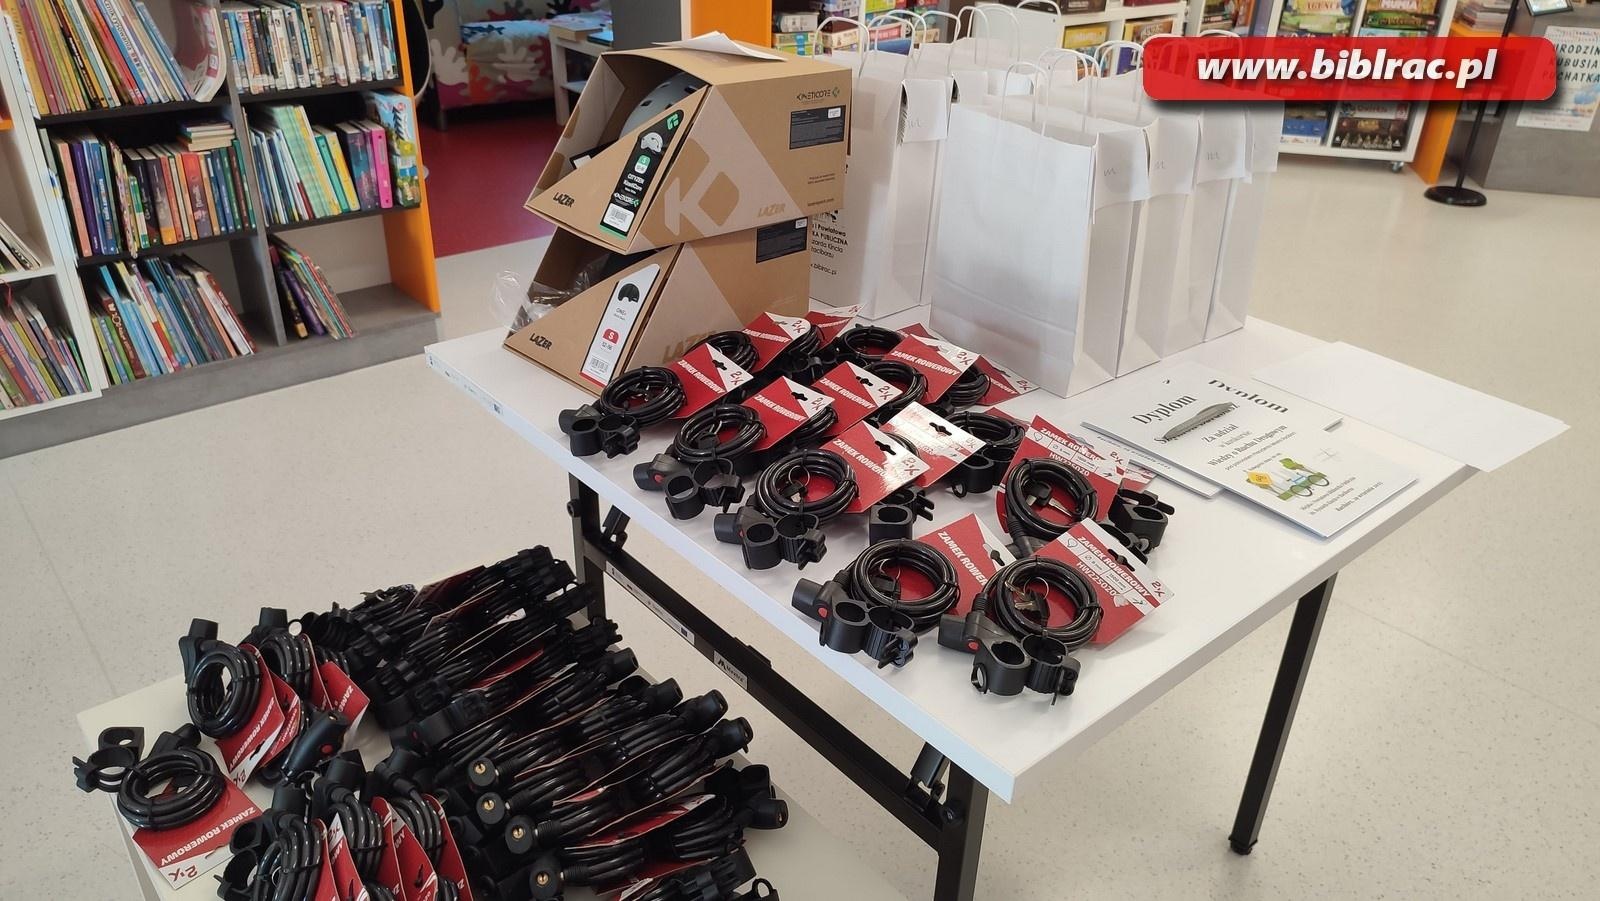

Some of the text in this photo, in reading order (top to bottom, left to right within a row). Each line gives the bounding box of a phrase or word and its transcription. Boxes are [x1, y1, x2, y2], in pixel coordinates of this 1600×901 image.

[553, 192, 574, 208] LAZER
[757, 203, 785, 217] LAZER
[529, 332, 552, 350] LAZER
[608, 331, 615, 340] S
[1131, 394, 1197, 425] Dyplom
[1040, 427, 1069, 445] ZAMEK
[832, 438, 860, 458] ZAMEK
[937, 530, 967, 558] ZAMEK
[1077, 536, 1151, 597] ZAMEK ROWEROWY
[1076, 561, 1118, 596] HW225020
[161, 806, 257, 867] ZAMEK ROWEROWY
